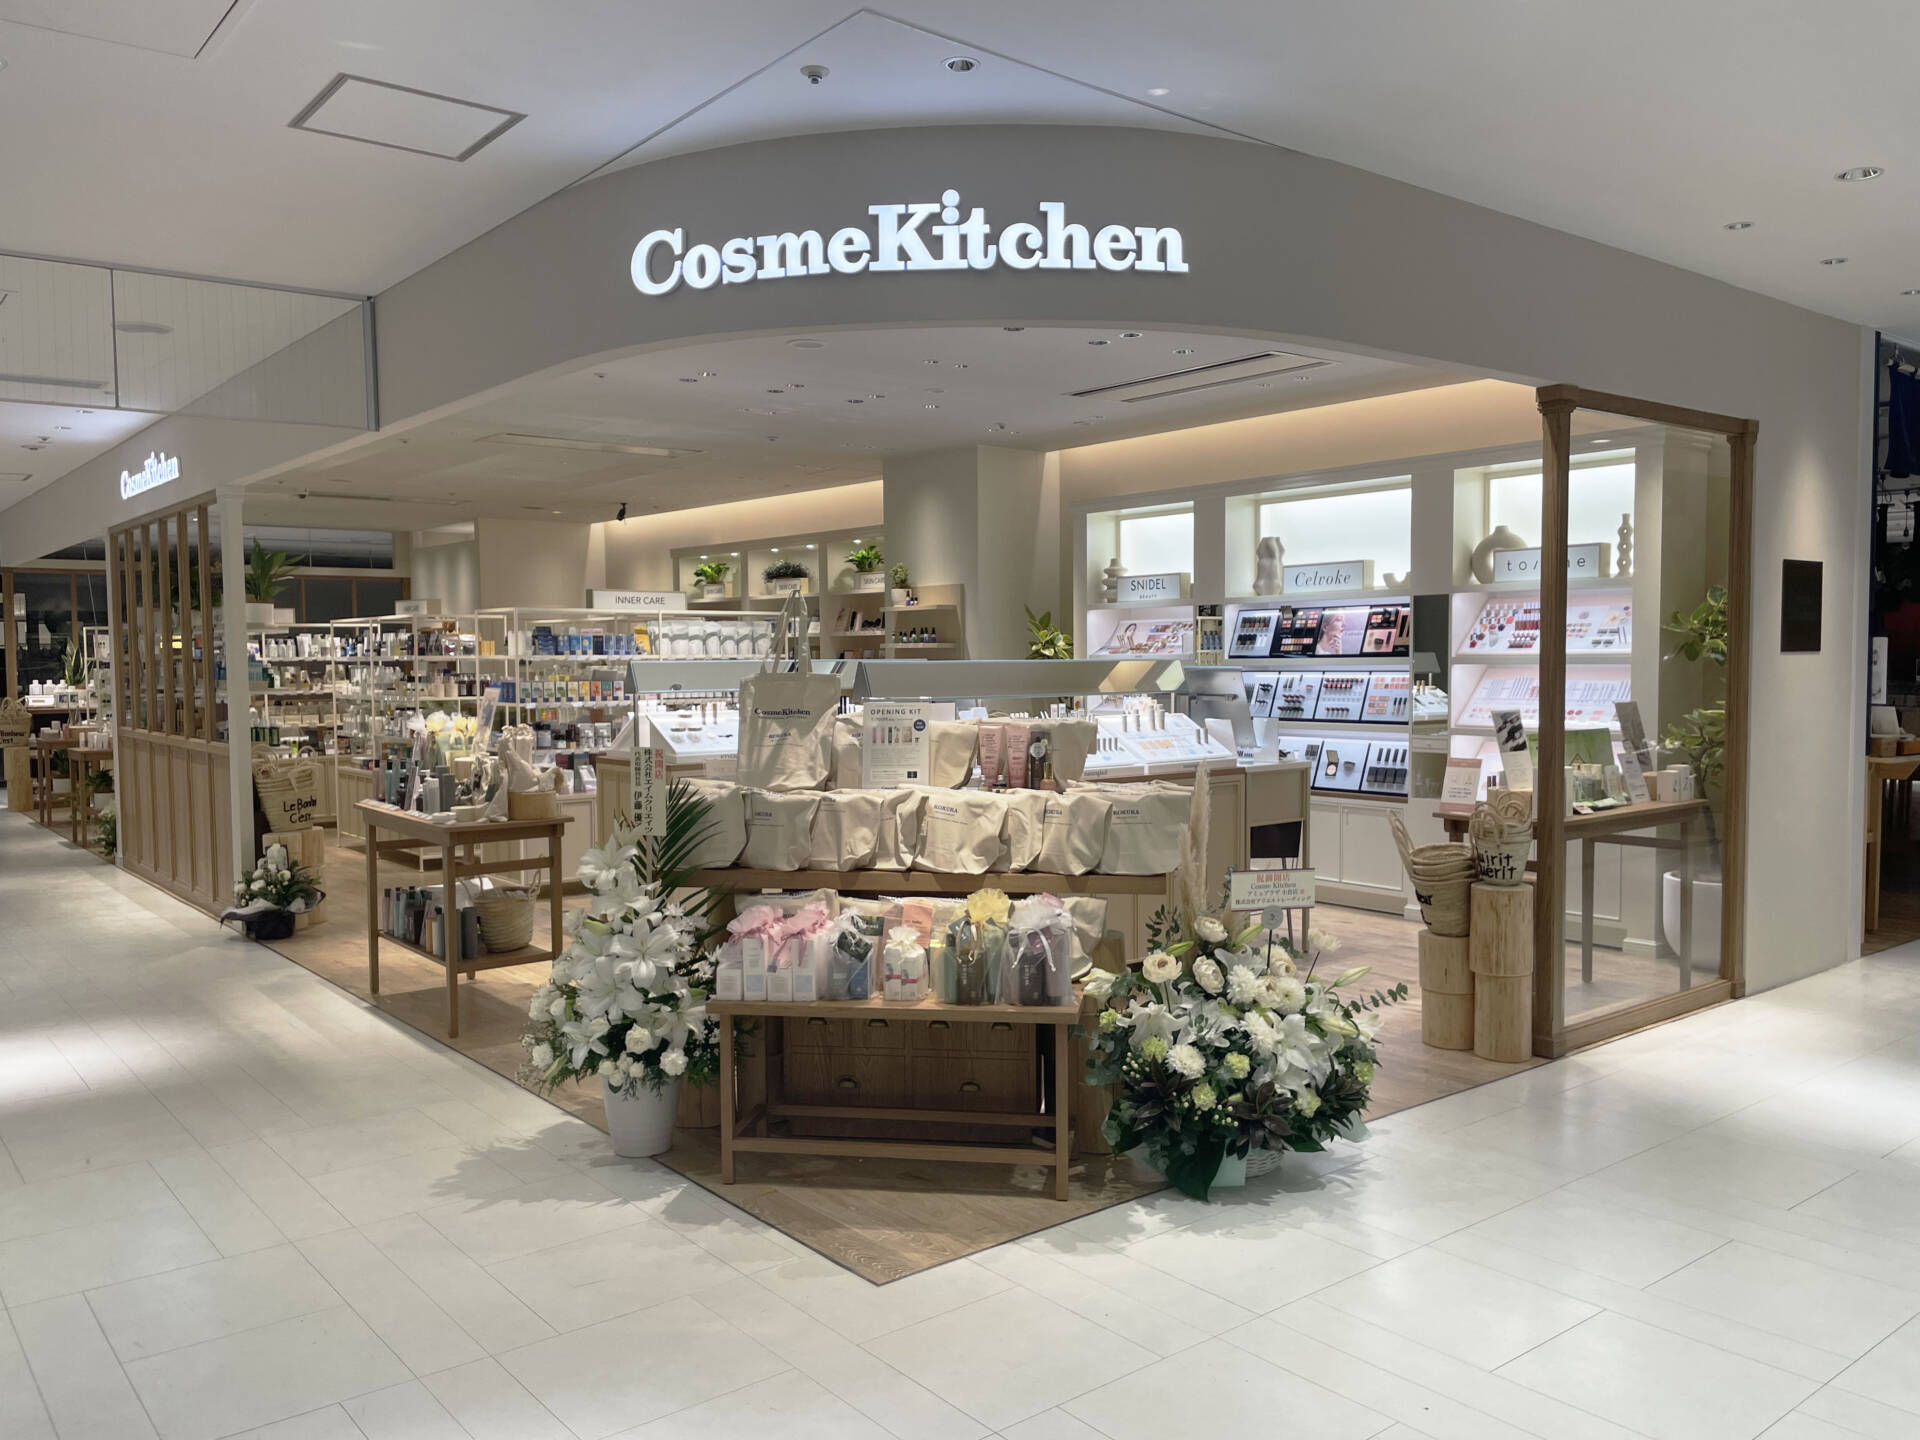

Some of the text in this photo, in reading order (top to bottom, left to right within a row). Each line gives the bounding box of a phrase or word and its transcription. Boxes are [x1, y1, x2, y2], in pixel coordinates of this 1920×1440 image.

[630, 189, 1190, 296] CosmeKitchen
[120, 451, 180, 500] CosmeKitchen
[1130, 578, 1167, 592] SNIDEL
[1295, 569, 1352, 587] Celvoke
[615, 595, 665, 605] INNER CARE
[283, 801, 296, 812] Le
